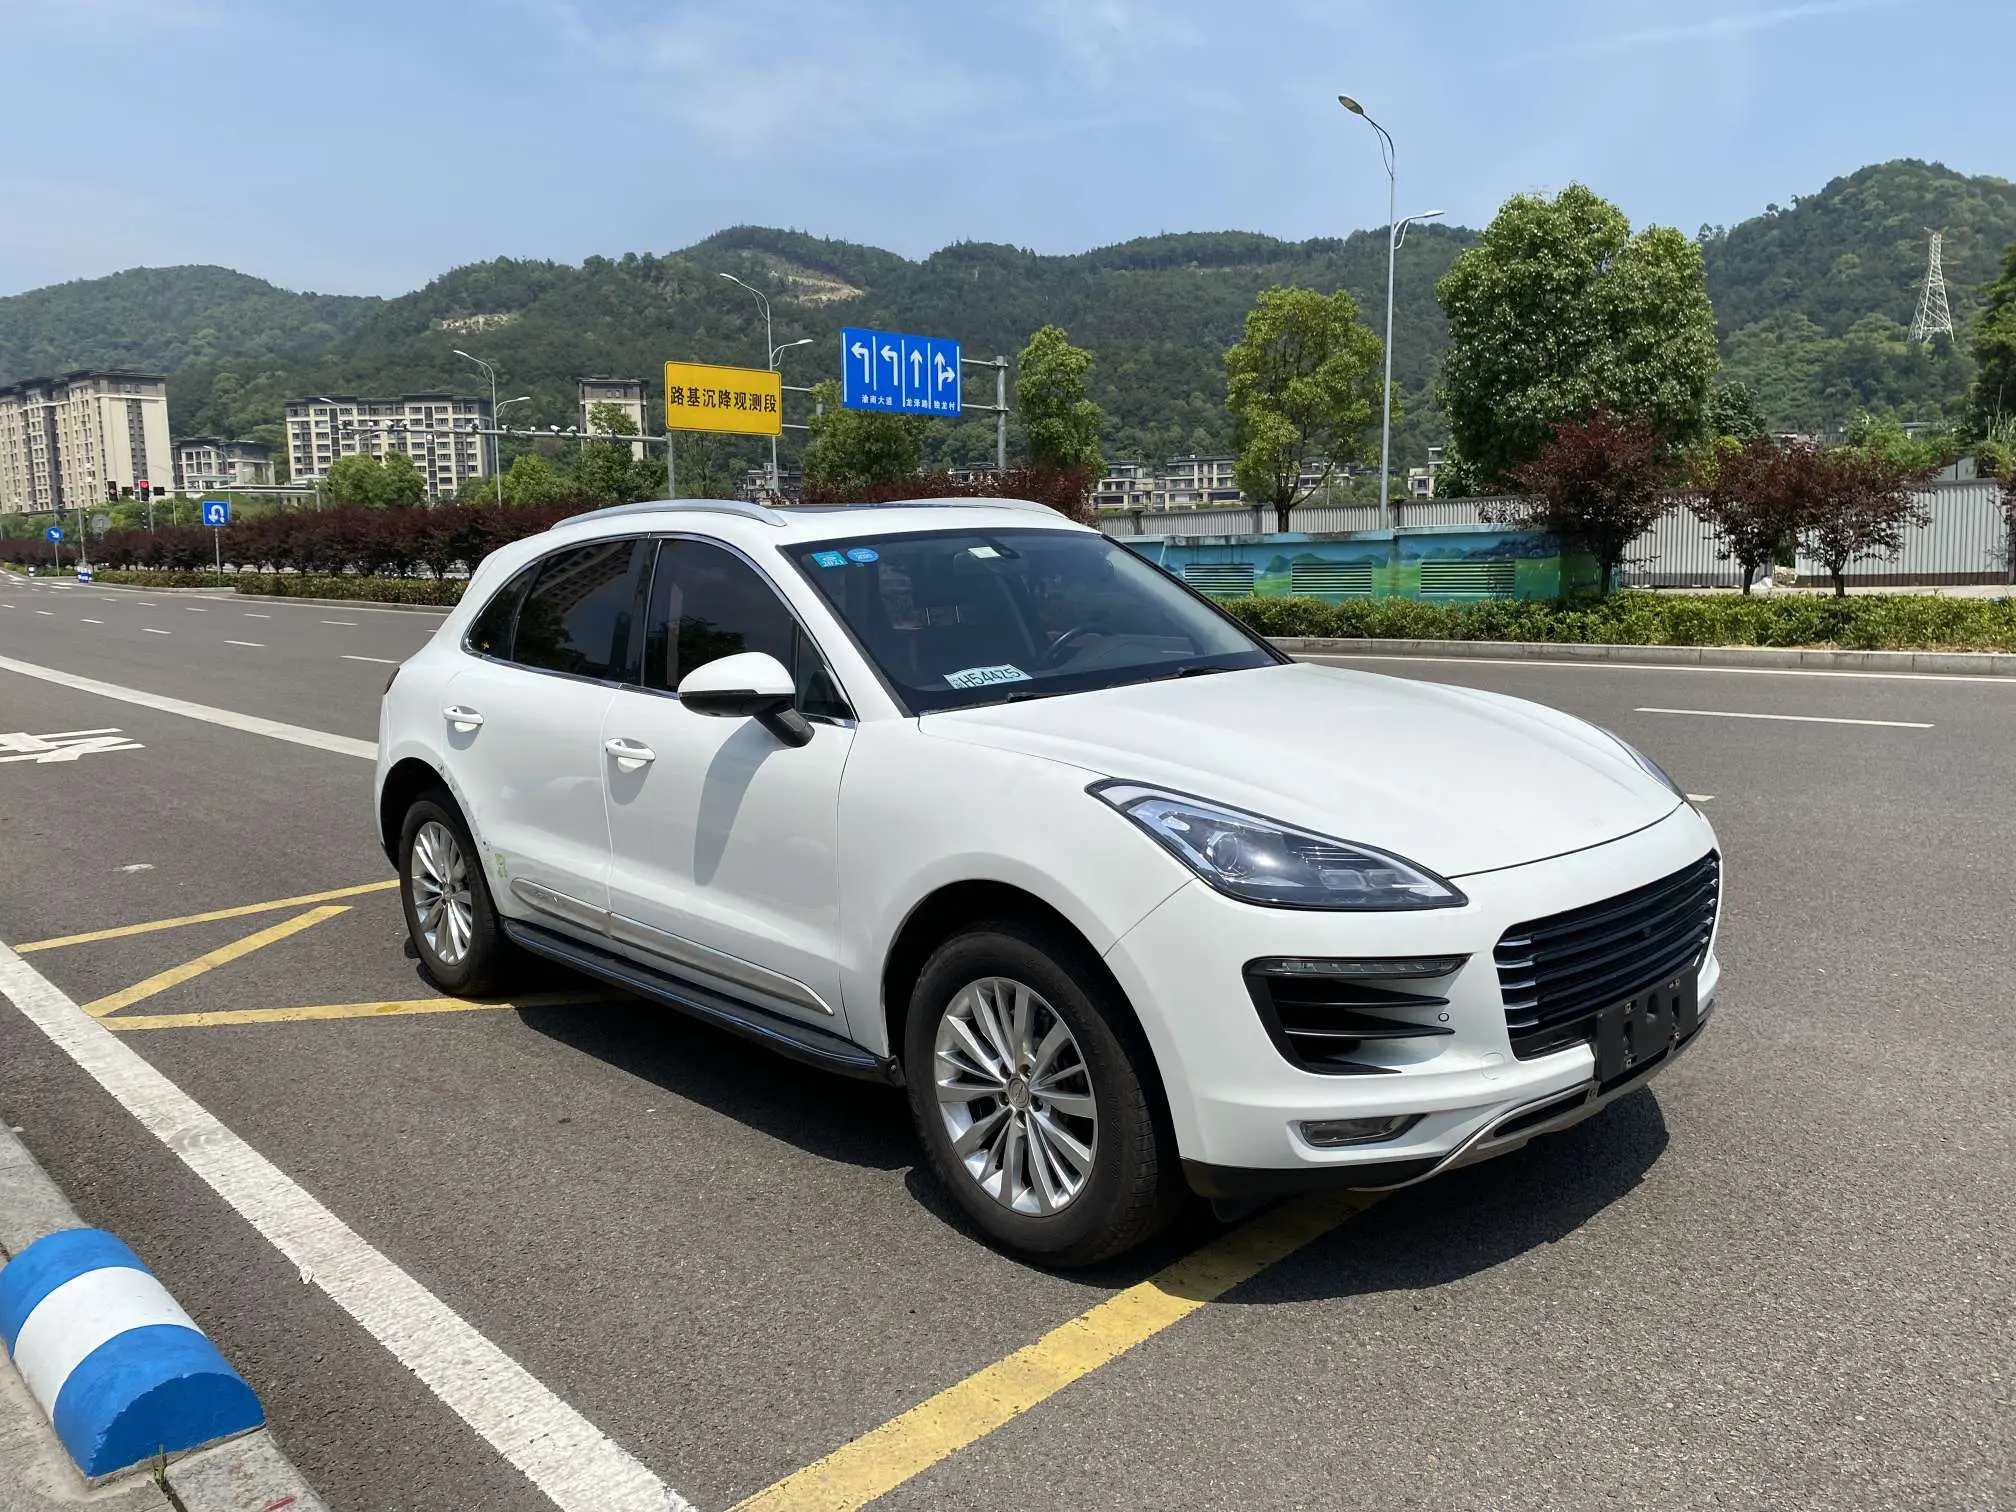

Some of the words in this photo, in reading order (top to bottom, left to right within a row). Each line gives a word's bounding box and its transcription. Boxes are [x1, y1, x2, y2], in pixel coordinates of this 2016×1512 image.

[670, 386, 777, 413] 路基沉降观测段
